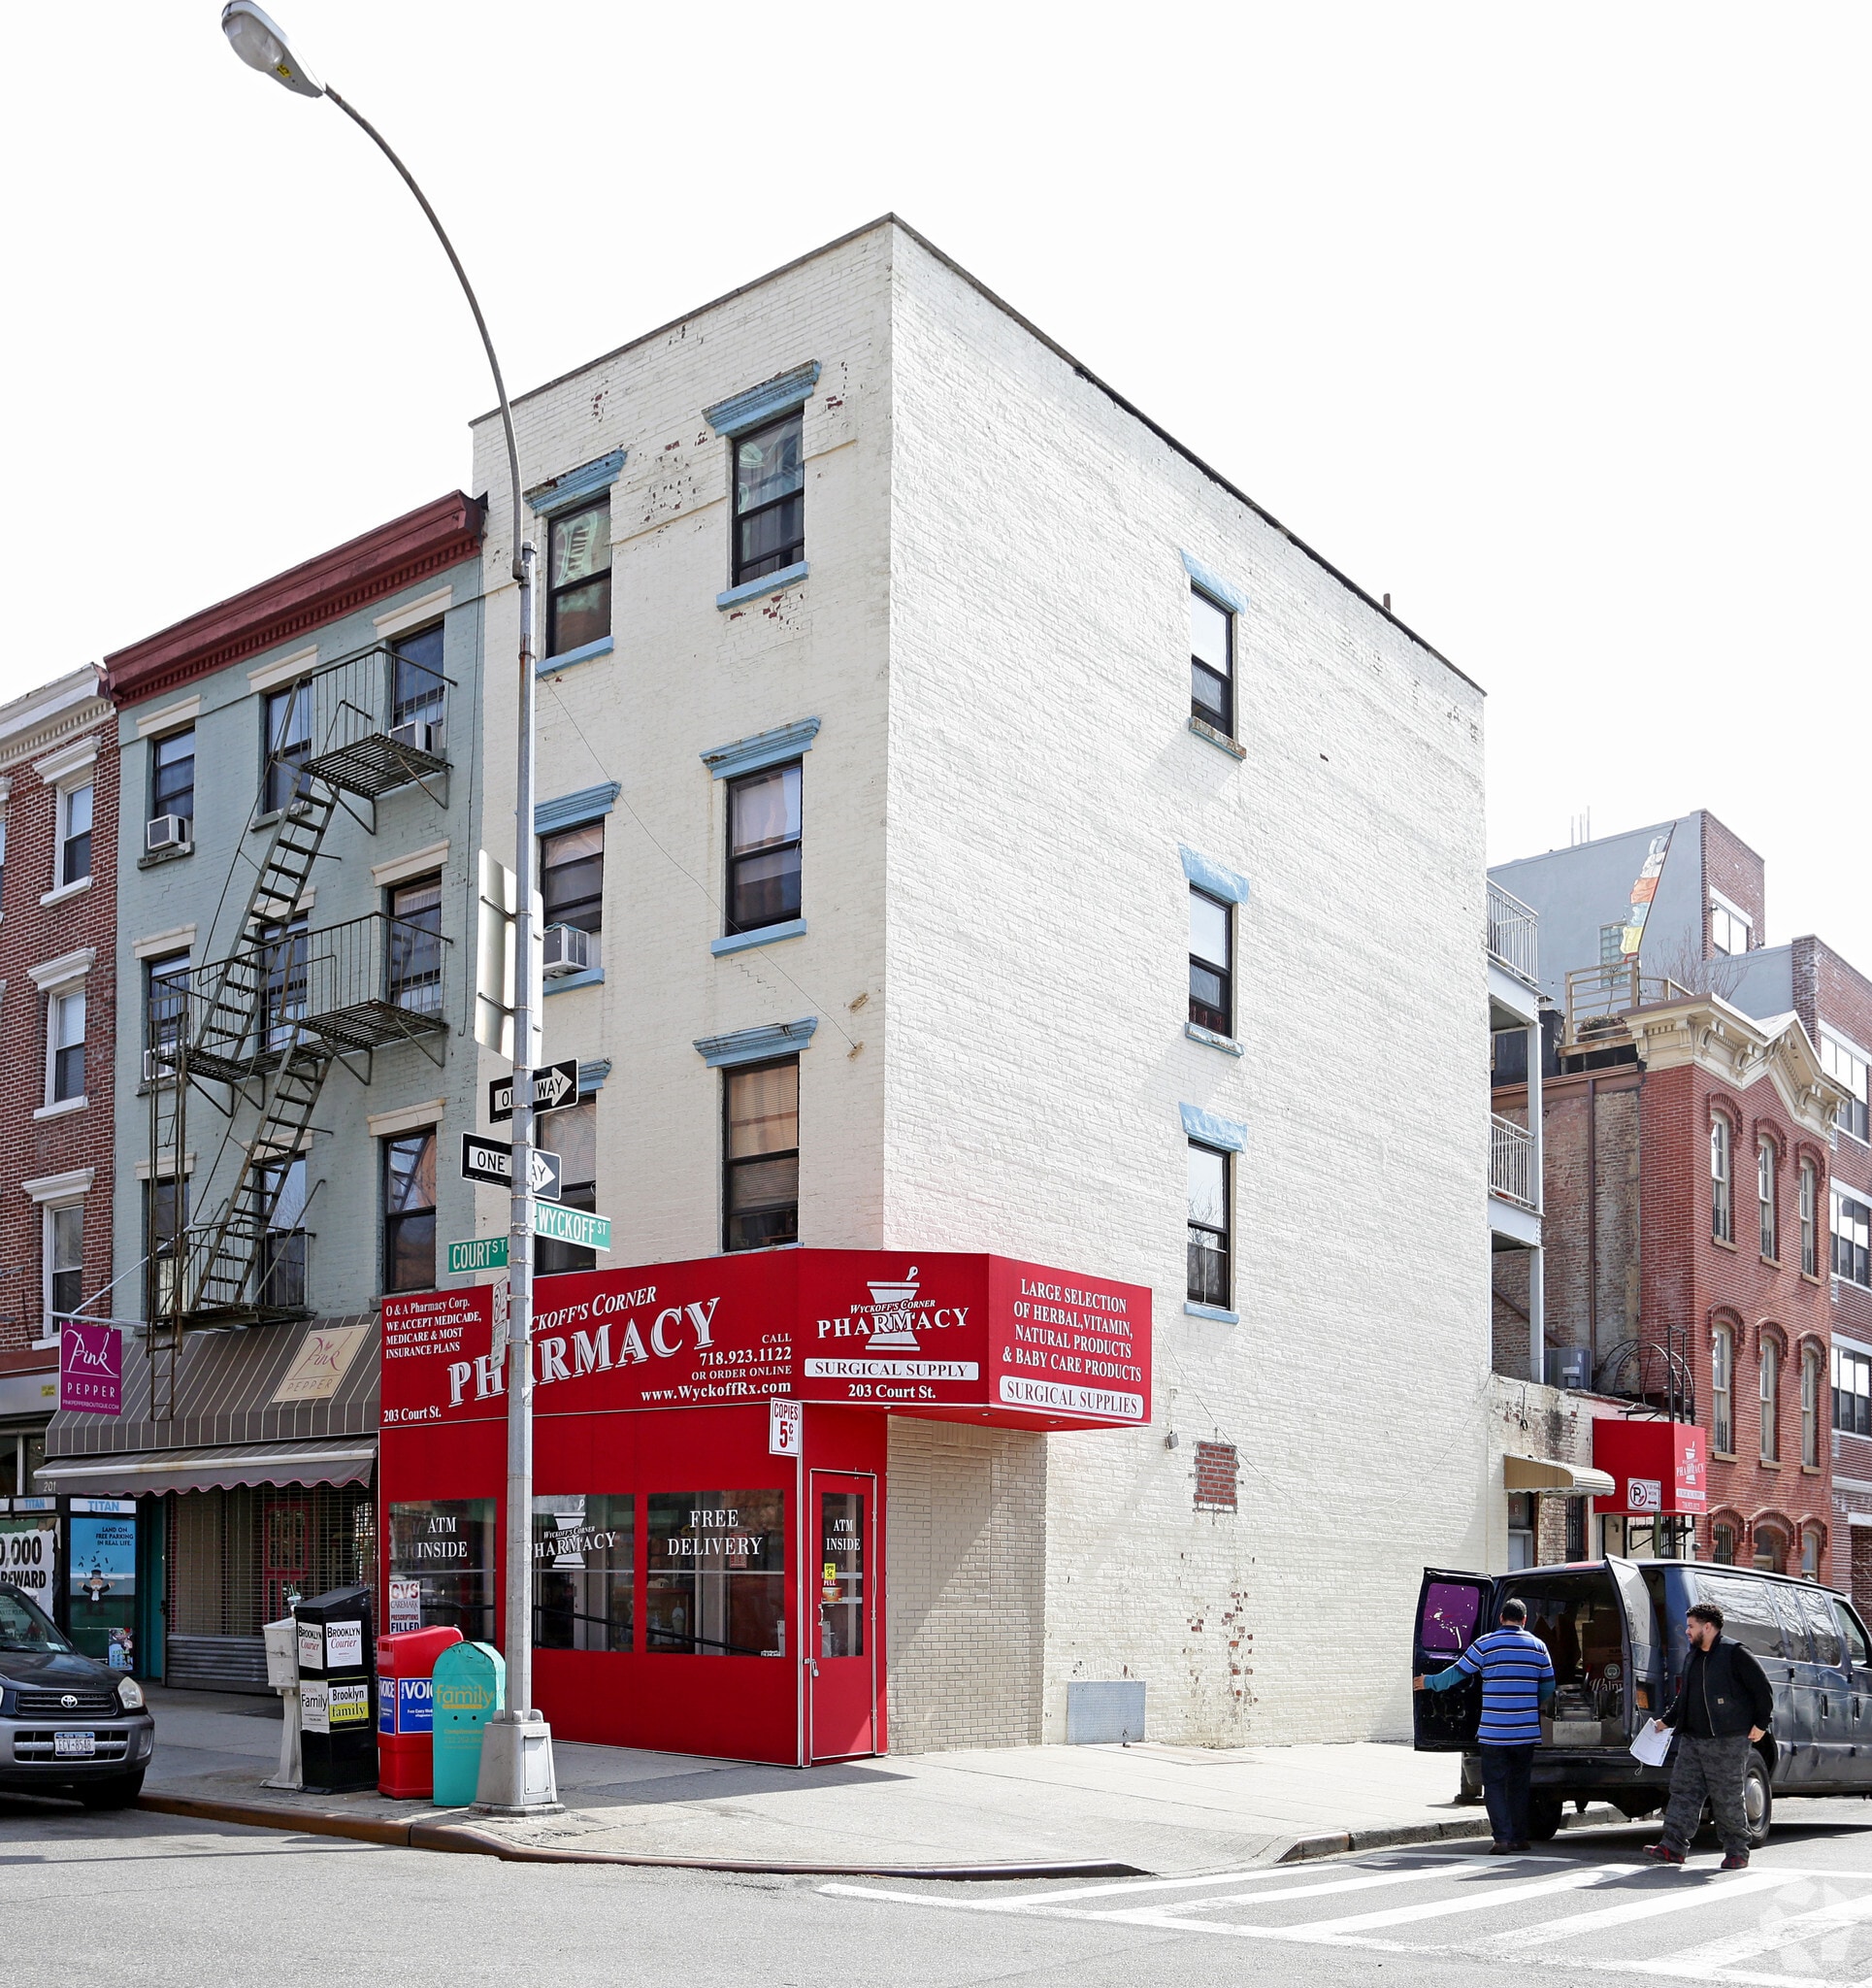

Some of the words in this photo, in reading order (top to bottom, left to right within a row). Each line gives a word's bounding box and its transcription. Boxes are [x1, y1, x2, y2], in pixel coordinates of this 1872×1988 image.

[538, 1077, 564, 1097] WAY
[477, 1151, 505, 1173] ONE
[538, 1206, 595, 1243] WYCKOFF
[597, 1221, 607, 1236] ST
[452, 1242, 491, 1270] COURT
[492, 1239, 506, 1253] ST
[1021, 1278, 1062, 1302] LARGE
[1065, 1287, 1127, 1313] SELECTION
[385, 1306, 393, 1316] O
[394, 1305, 401, 1315] &
[402, 1305, 409, 1315] A
[410, 1302, 447, 1314] Pharmacy
[448, 1297, 471, 1309] Corp.
[530, 1303, 589, 1334] CKOFF'S
[592, 1286, 657, 1316] CORNER
[850, 1302, 900, 1314] WYCKOFF'S
[901, 1299, 936, 1309] CORNER
[1014, 1301, 1030, 1318] OF
[386, 1321, 399, 1332] WE
[400, 1317, 433, 1328] ACCEPT
[434, 1311, 481, 1327] MEDICADE,
[816, 1308, 969, 1339] PHARMACY
[386, 1331, 429, 1345] MEDICARE
[431, 1330, 438, 1341] &
[439, 1327, 464, 1340] MOST
[762, 1333, 792, 1343] CALL
[1015, 1324, 1070, 1349] NATURAL
[1073, 1335, 1132, 1359] PRODUCTS
[63, 1329, 119, 1375] Pink
[293, 1331, 353, 1379] Pink
[385, 1344, 432, 1359] INSURANCE
[433, 1342, 460, 1353] PLANS
[447, 1297, 720, 1408] PHRMACY
[699, 1346, 792, 1366] 718.923.1122
[815, 1362, 902, 1376] SURGICAL
[905, 1364, 968, 1376] SUPPLY
[1002, 1346, 1012, 1363] &
[1015, 1348, 1048, 1368] BABY
[1050, 1354, 1082, 1374] CARE
[1085, 1359, 1141, 1382] PRODUCTS
[692, 1371, 706, 1380] OR
[709, 1369, 746, 1379] ORDER
[749, 1366, 792, 1376] ONLINE
[67, 1382, 115, 1398] PEPPER
[286, 1379, 333, 1392] PEPPER
[641, 1381, 791, 1402] www.WyckoffRx.com
[848, 1384, 871, 1397] 203
[875, 1384, 915, 1398] Court
[918, 1385, 936, 1398] St.
[1007, 1381, 1075, 1407] SURGICAL
[1079, 1391, 1137, 1414] SUPPLIES
[383, 1408, 400, 1422] 203
[401, 1408, 427, 1421] Court
[429, 1406, 442, 1418] St.
[774, 1403, 799, 1420] COPIES
[43, 1481, 56, 1492] 201
[24, 1498, 46, 1509] TITAN
[87, 1501, 119, 1511] TITAN
[427, 1516, 457, 1533] ATM
[690, 1509, 739, 1528] FREE
[833, 1519, 853, 1532] ATM
[417, 1541, 468, 1558] INSIDE
[668, 1537, 763, 1556] DELIVERY
[826, 1538, 861, 1551] INSIDE
[391, 1583, 418, 1599] CVS
[391, 1601, 418, 1611] CAREMARK
[298, 1626, 322, 1640] BROOKLYN
[327, 1627, 360, 1639] BROOKLYN
[391, 1622, 419, 1633] FILLED
[301, 1639, 319, 1651] Courier
[331, 1638, 357, 1649] Courier
[332, 1686, 365, 1703] Brooklyn
[380, 1679, 395, 1699] VOICE
[436, 1684, 494, 1708] family
[301, 1694, 328, 1711] Family
[332, 1704, 365, 1717] family
